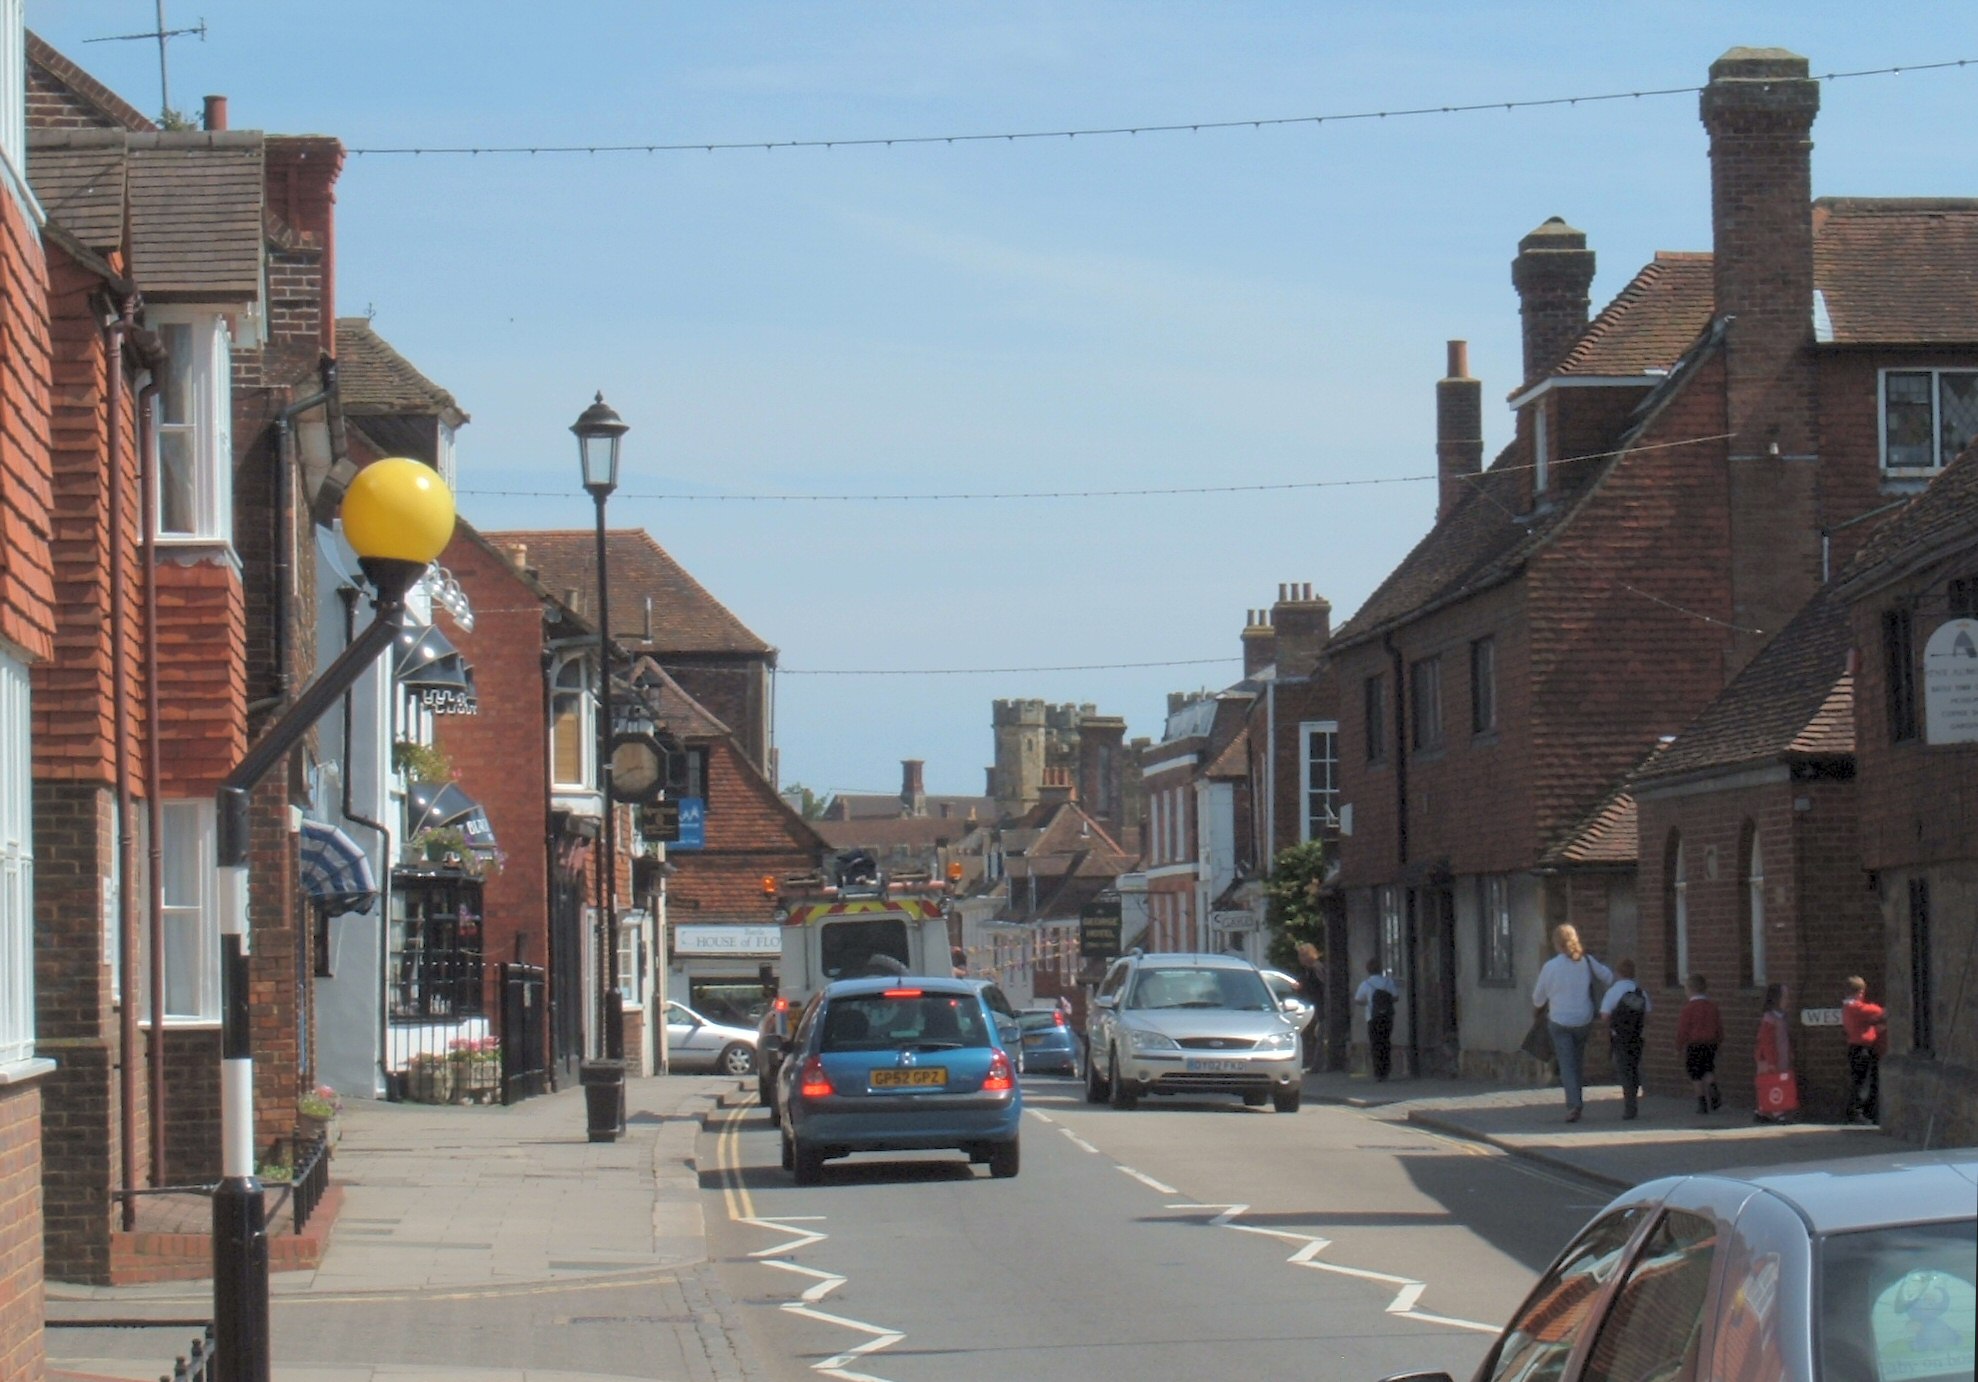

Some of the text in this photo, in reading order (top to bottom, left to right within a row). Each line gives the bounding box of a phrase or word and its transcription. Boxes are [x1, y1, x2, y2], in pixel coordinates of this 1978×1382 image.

[696, 936, 781, 947] HOUSE of FLO
[1807, 1010, 1841, 1023] WES
[875, 1070, 939, 1085] GP52 GPZ
